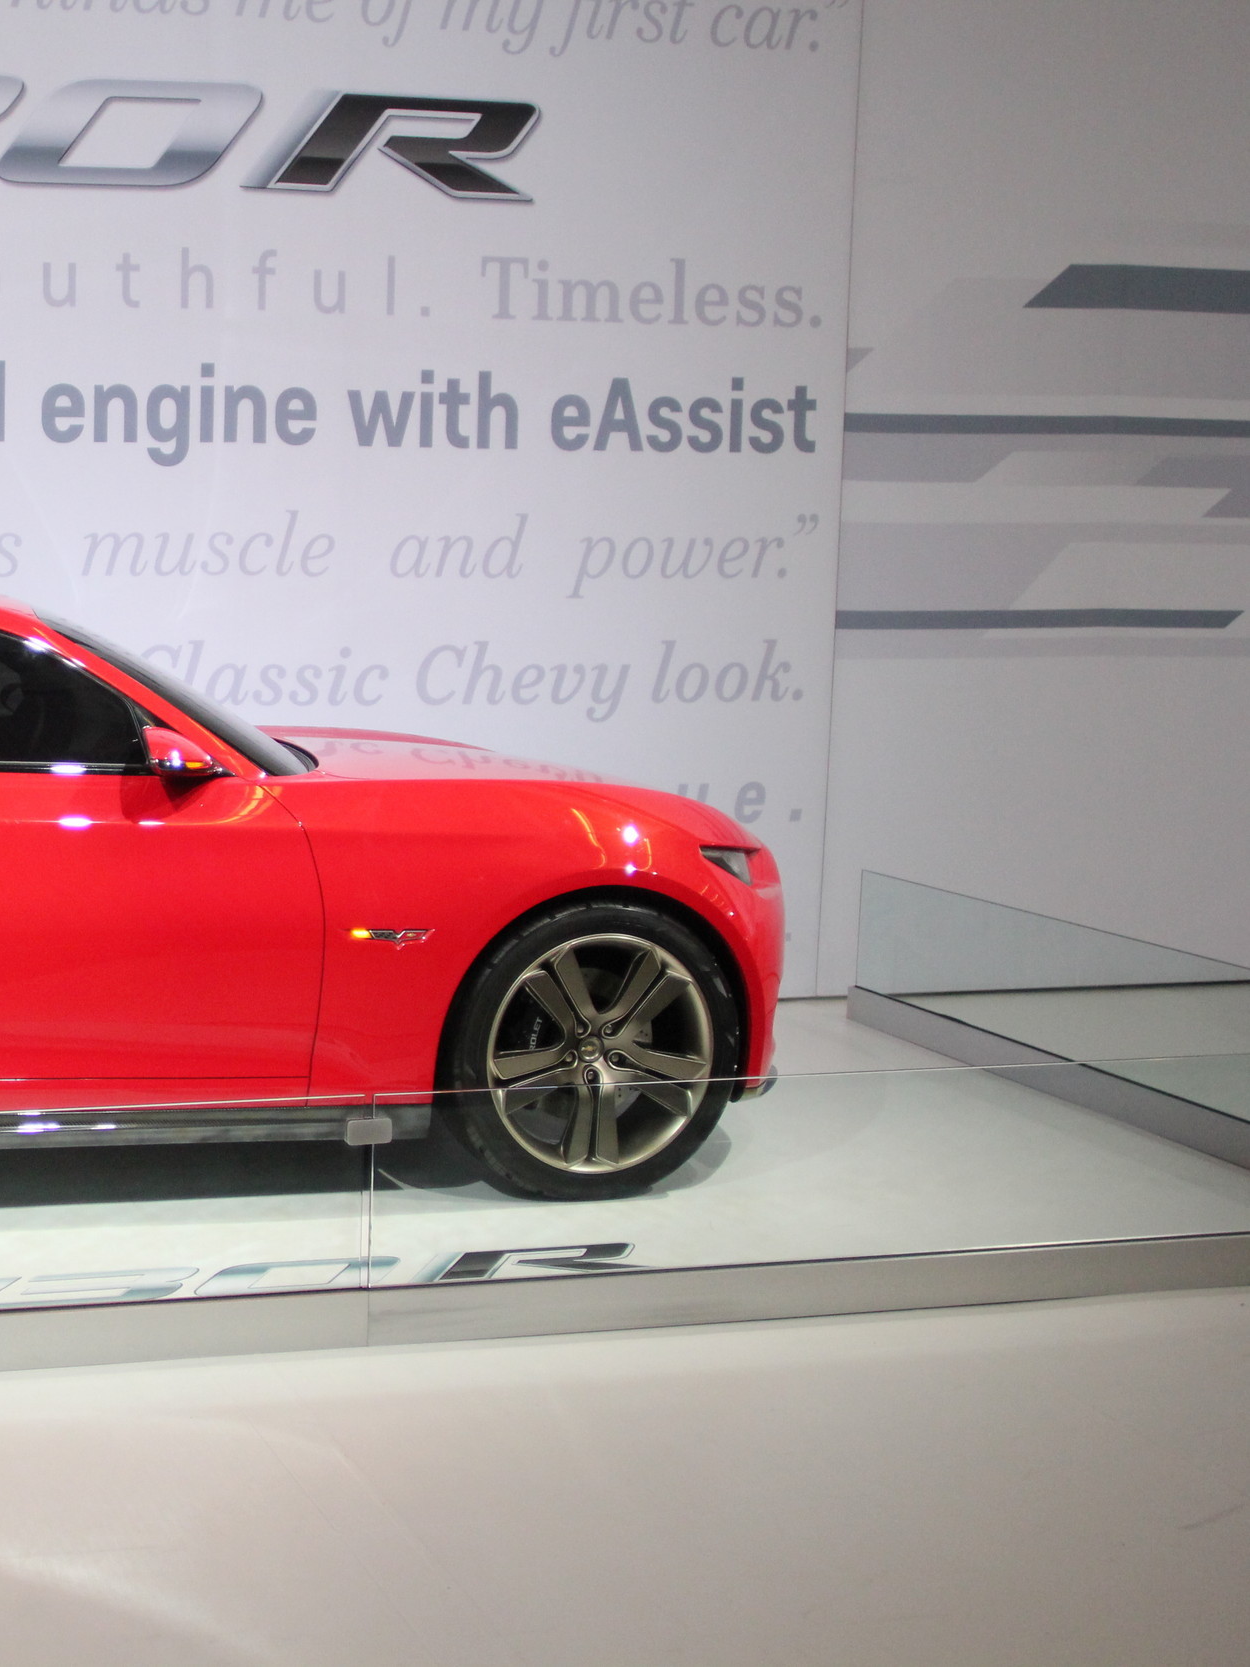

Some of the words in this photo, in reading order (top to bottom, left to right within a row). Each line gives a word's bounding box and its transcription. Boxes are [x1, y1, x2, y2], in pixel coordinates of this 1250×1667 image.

[480, 255, 823, 328] Timeless.
[41, 362, 317, 467] engine
[347, 369, 519, 450] with
[551, 376, 818, 455] eAssist
[81, 508, 336, 578] muscle
[389, 512, 530, 580] and
[566, 512, 821, 600] power.”
[415, 639, 632, 724] Chevy
[650, 638, 805, 704] look.
